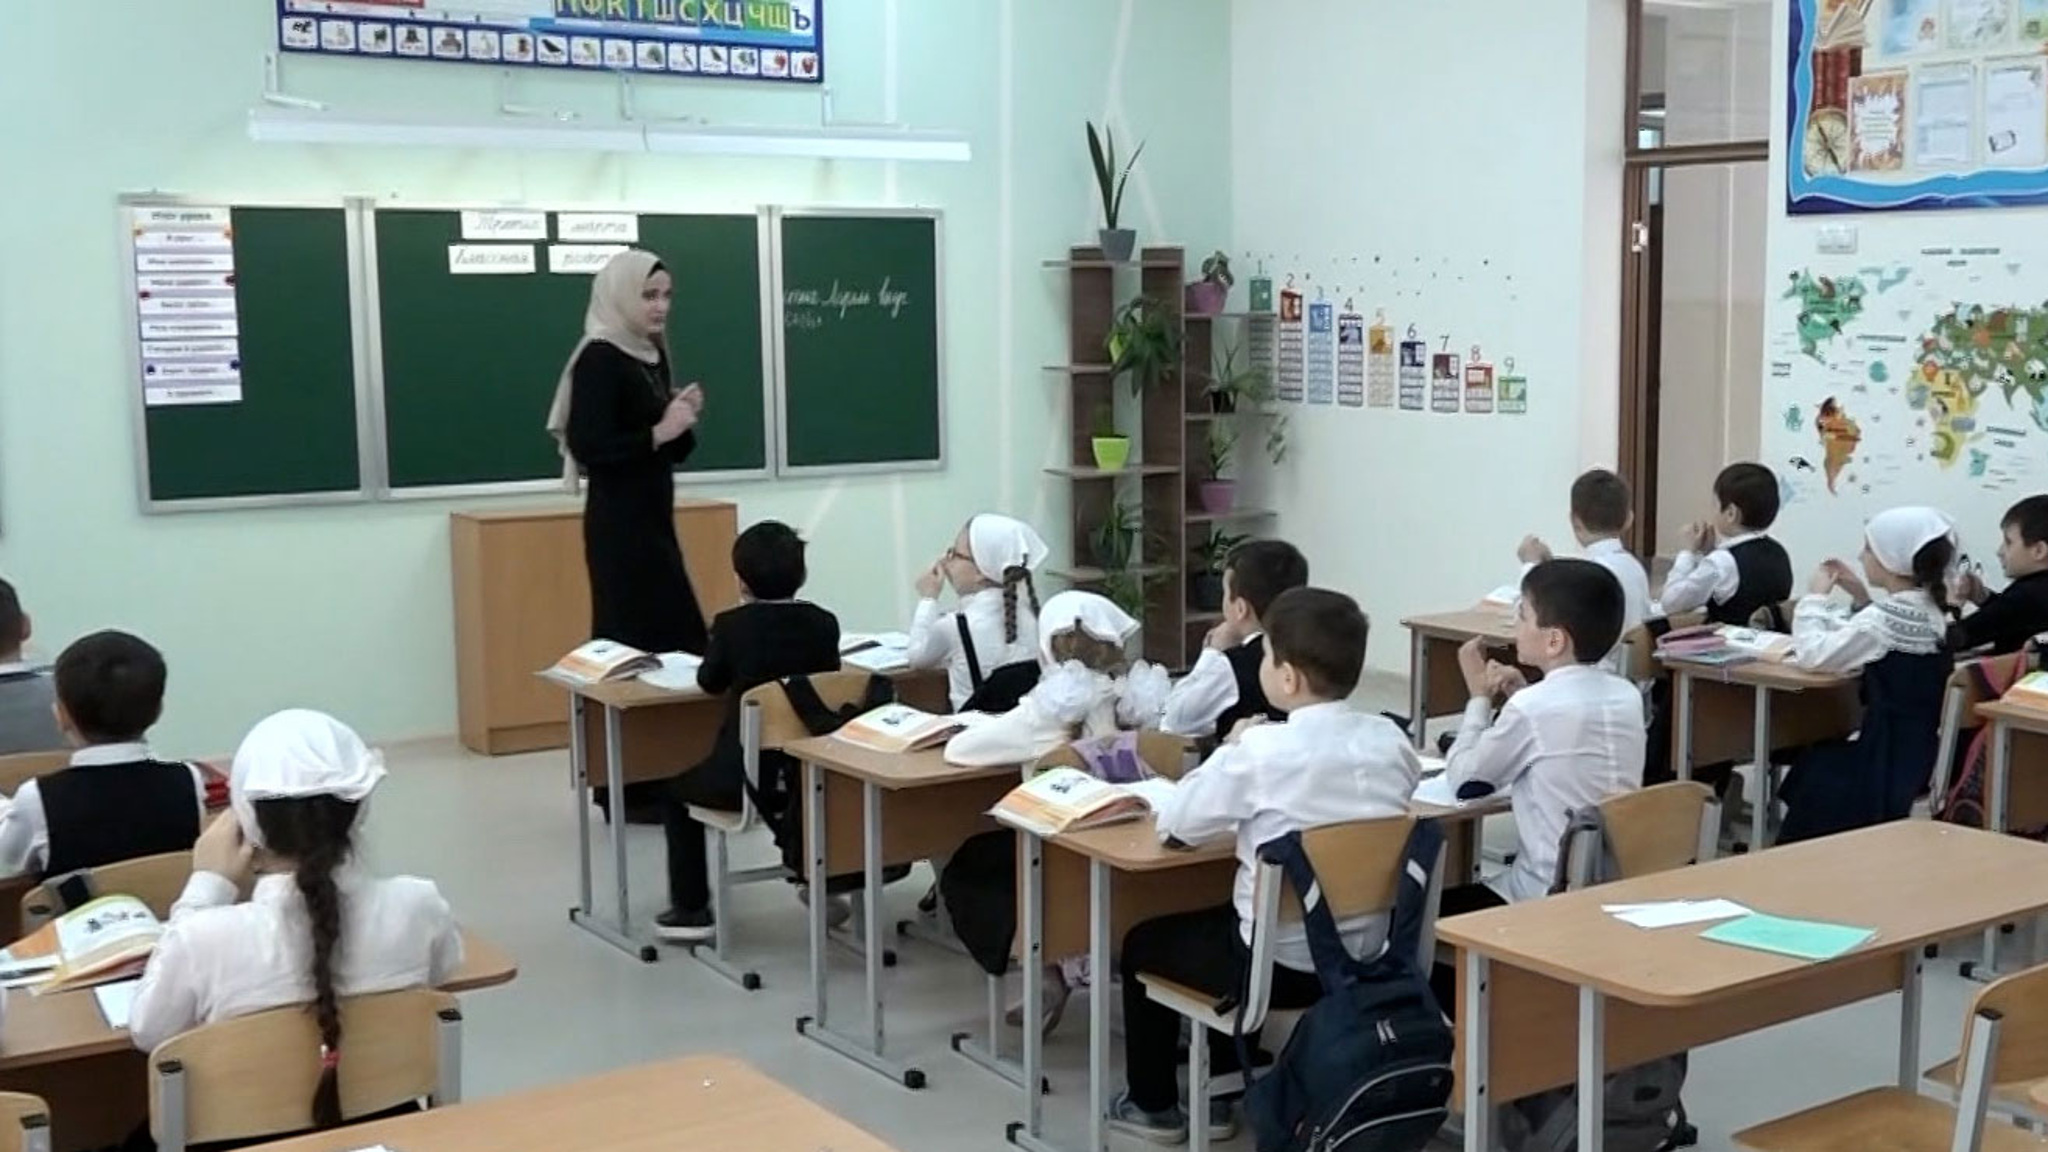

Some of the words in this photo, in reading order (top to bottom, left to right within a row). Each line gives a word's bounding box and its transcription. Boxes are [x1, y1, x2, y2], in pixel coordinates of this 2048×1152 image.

[1407, 323, 1417, 339] 6
[1440, 335, 1450, 351] 7
[1470, 344, 1481, 362] 8
[1504, 357, 1514, 373] 9
